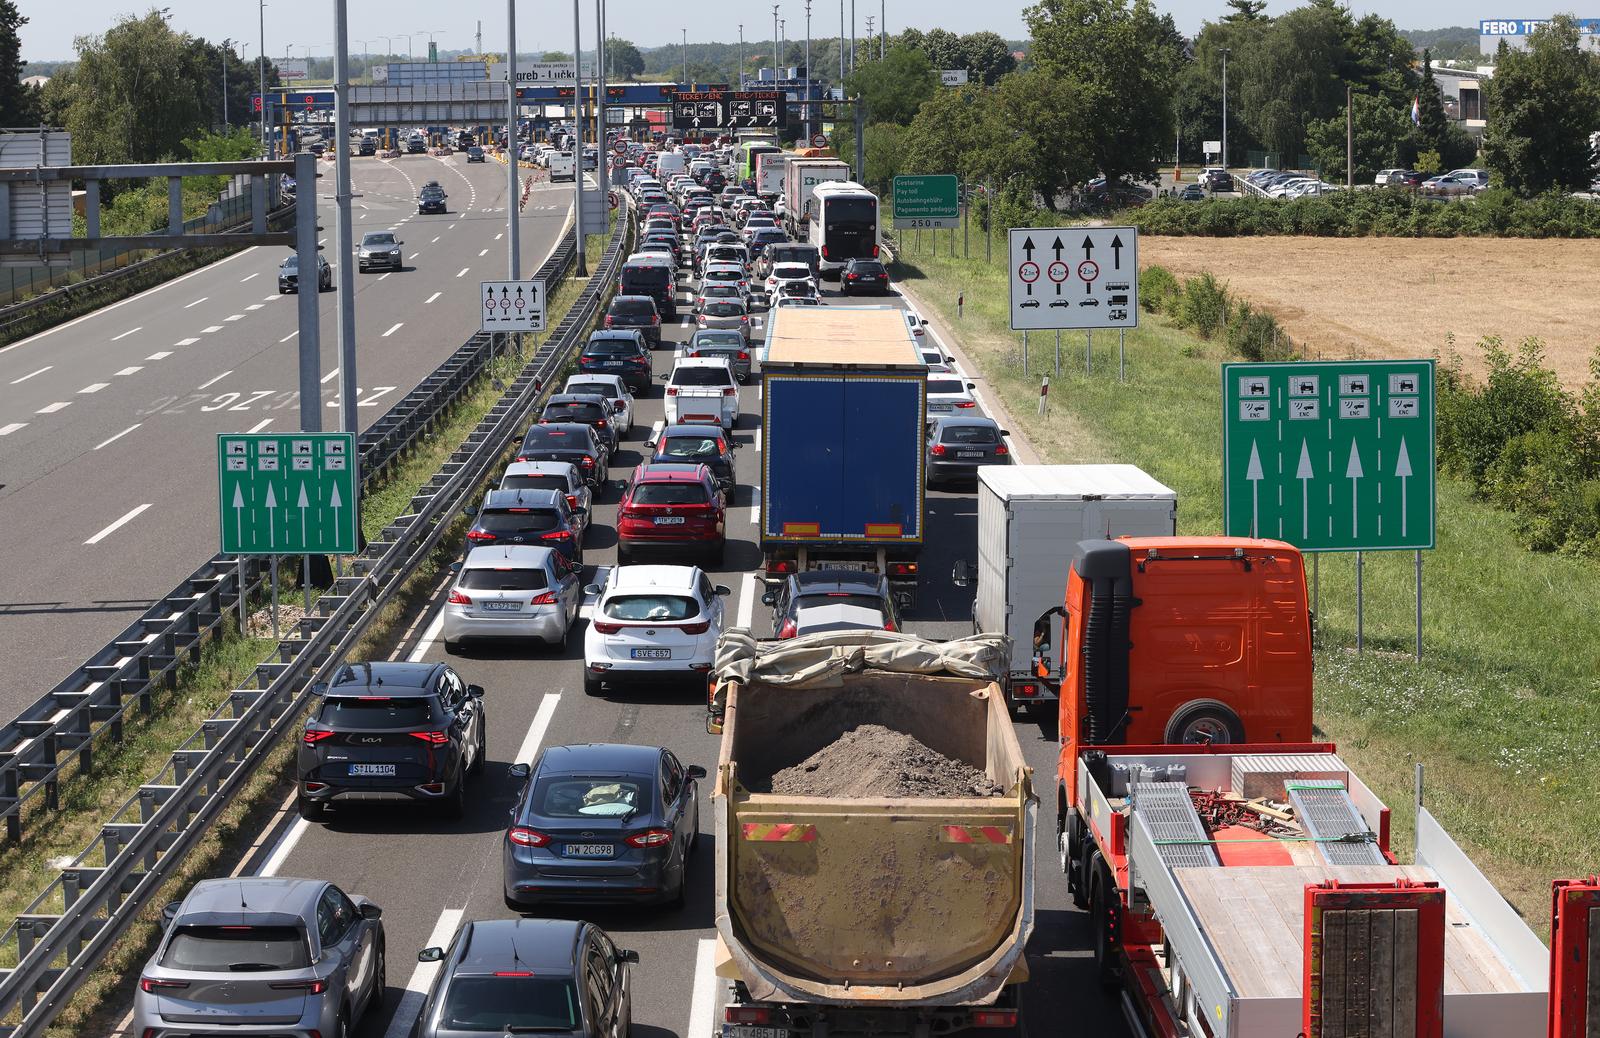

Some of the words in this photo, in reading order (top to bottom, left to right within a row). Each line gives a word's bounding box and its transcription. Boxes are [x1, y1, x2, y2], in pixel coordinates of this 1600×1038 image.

[1482, 22, 1517, 34] FERO
[637, 650, 669, 658] SVE-657
[375, 765, 395, 774] 1104
[567, 845, 580, 855] DW
[583, 845, 612, 855] 2CG98
